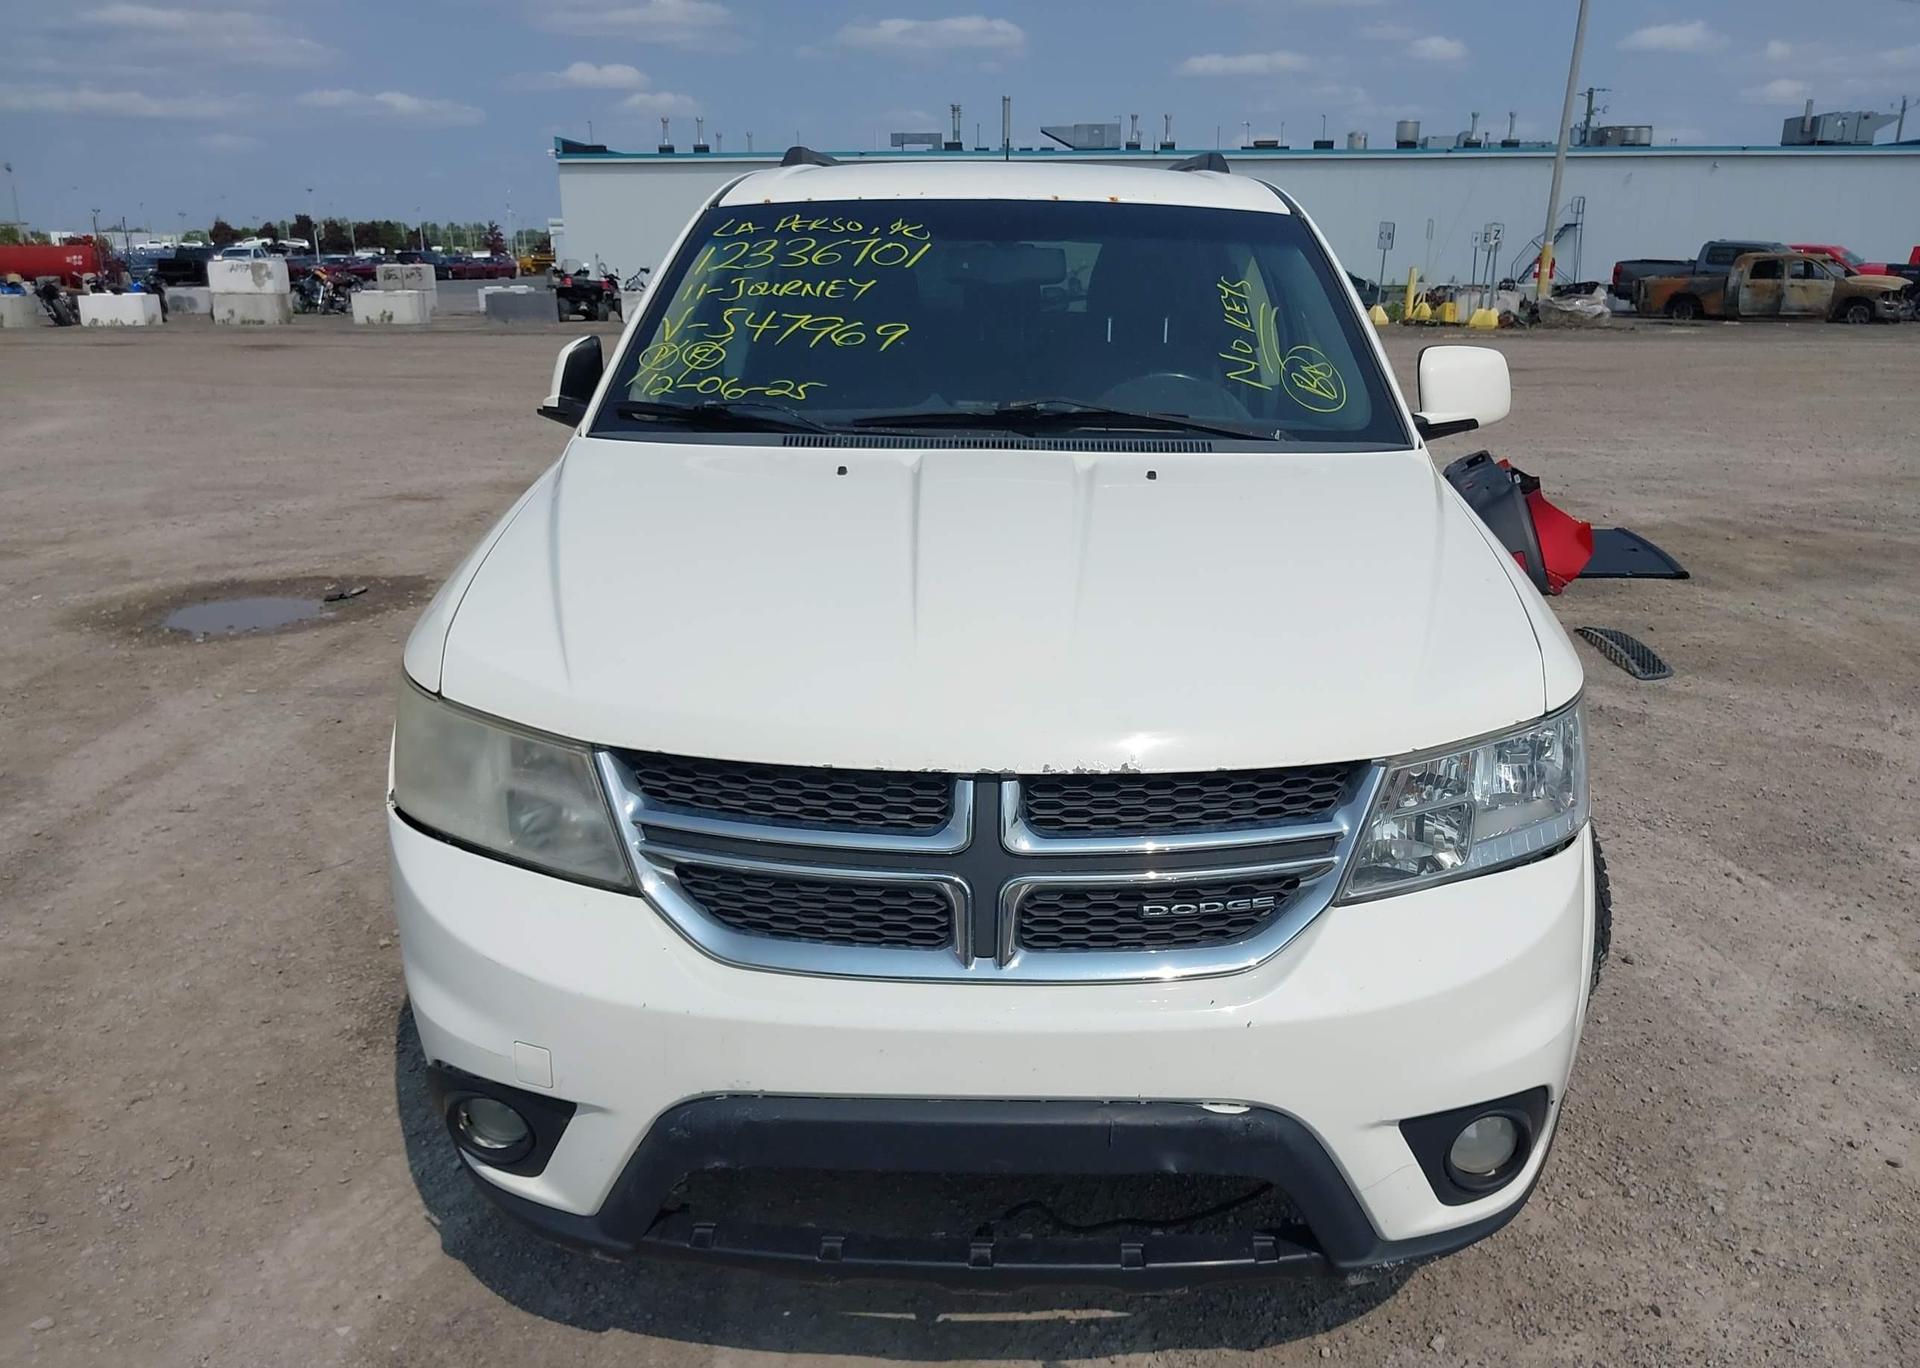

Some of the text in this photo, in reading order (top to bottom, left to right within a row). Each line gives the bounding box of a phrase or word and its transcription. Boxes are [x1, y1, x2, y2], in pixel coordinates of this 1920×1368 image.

[694, 237, 932, 275] 12336701
[681, 276, 877, 301] 11-JOURNEY
[661, 306, 910, 352] V-547969
[1216, 275, 1273, 391] NO KEYS
[641, 373, 828, 400] 12-06-25
[1142, 895, 1275, 917] DODGE
